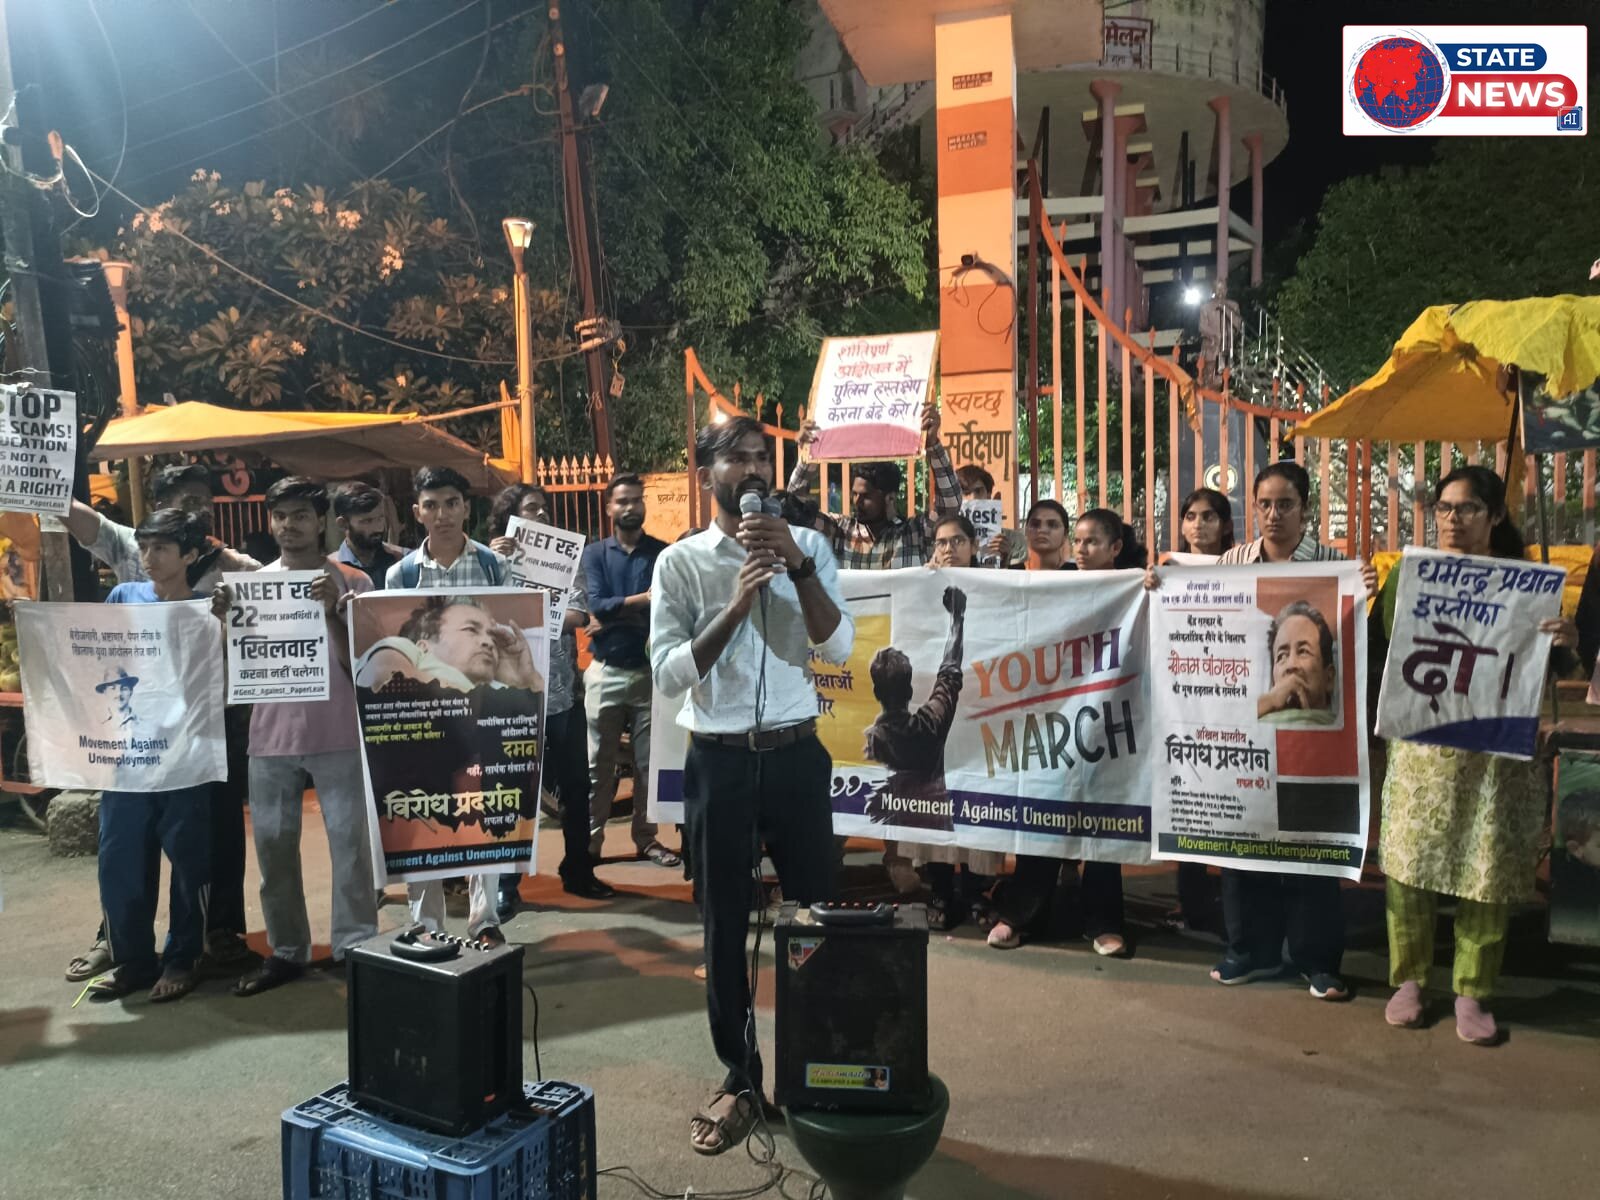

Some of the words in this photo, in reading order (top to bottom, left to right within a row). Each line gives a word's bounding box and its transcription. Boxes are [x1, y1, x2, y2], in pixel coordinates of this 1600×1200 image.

[0, 390, 61, 419] TOP
[832, 380, 872, 405] पुलिस
[828, 407, 864, 422] करना
[10, 421, 72, 438] SCAMS!
[11, 452, 36, 463] NOT
[39, 455, 47, 464] A
[943, 420, 1012, 481] सर्वेक्षण
[6, 480, 15, 492] A
[20, 481, 69, 497] RIGHT!
[514, 526, 554, 550] NEET
[235, 582, 284, 600] NEET
[1498, 565, 1567, 594] प्रधान
[232, 606, 258, 627] 22
[1412, 590, 1506, 626] इस्तीफा
[233, 635, 324, 662] 'खिलवाड़'
[240, 668, 268, 680] करना
[270, 665, 290, 678] नहीं
[292, 665, 324, 677] चलेगा।
[971, 627, 1122, 698] YOUTH
[79, 736, 128, 750] Movement
[131, 737, 168, 752] Against
[502, 740, 537, 758] दमन
[980, 700, 1136, 778] MARCH
[88, 753, 161, 767] Unemployment
[1165, 734, 1213, 771] विरोध
[1214, 740, 1270, 772] प्रदर्शन
[383, 789, 451, 826] विरोध
[452, 782, 523, 816] प्रदर्शन
[881, 793, 955, 816] Movement
[960, 800, 1018, 823] Against
[1023, 806, 1144, 835] Unemployment
[425, 850, 463, 866] Against
[1177, 836, 1228, 851] Movement
[1230, 839, 1269, 855] Against
[1270, 842, 1350, 860] Unemployment
